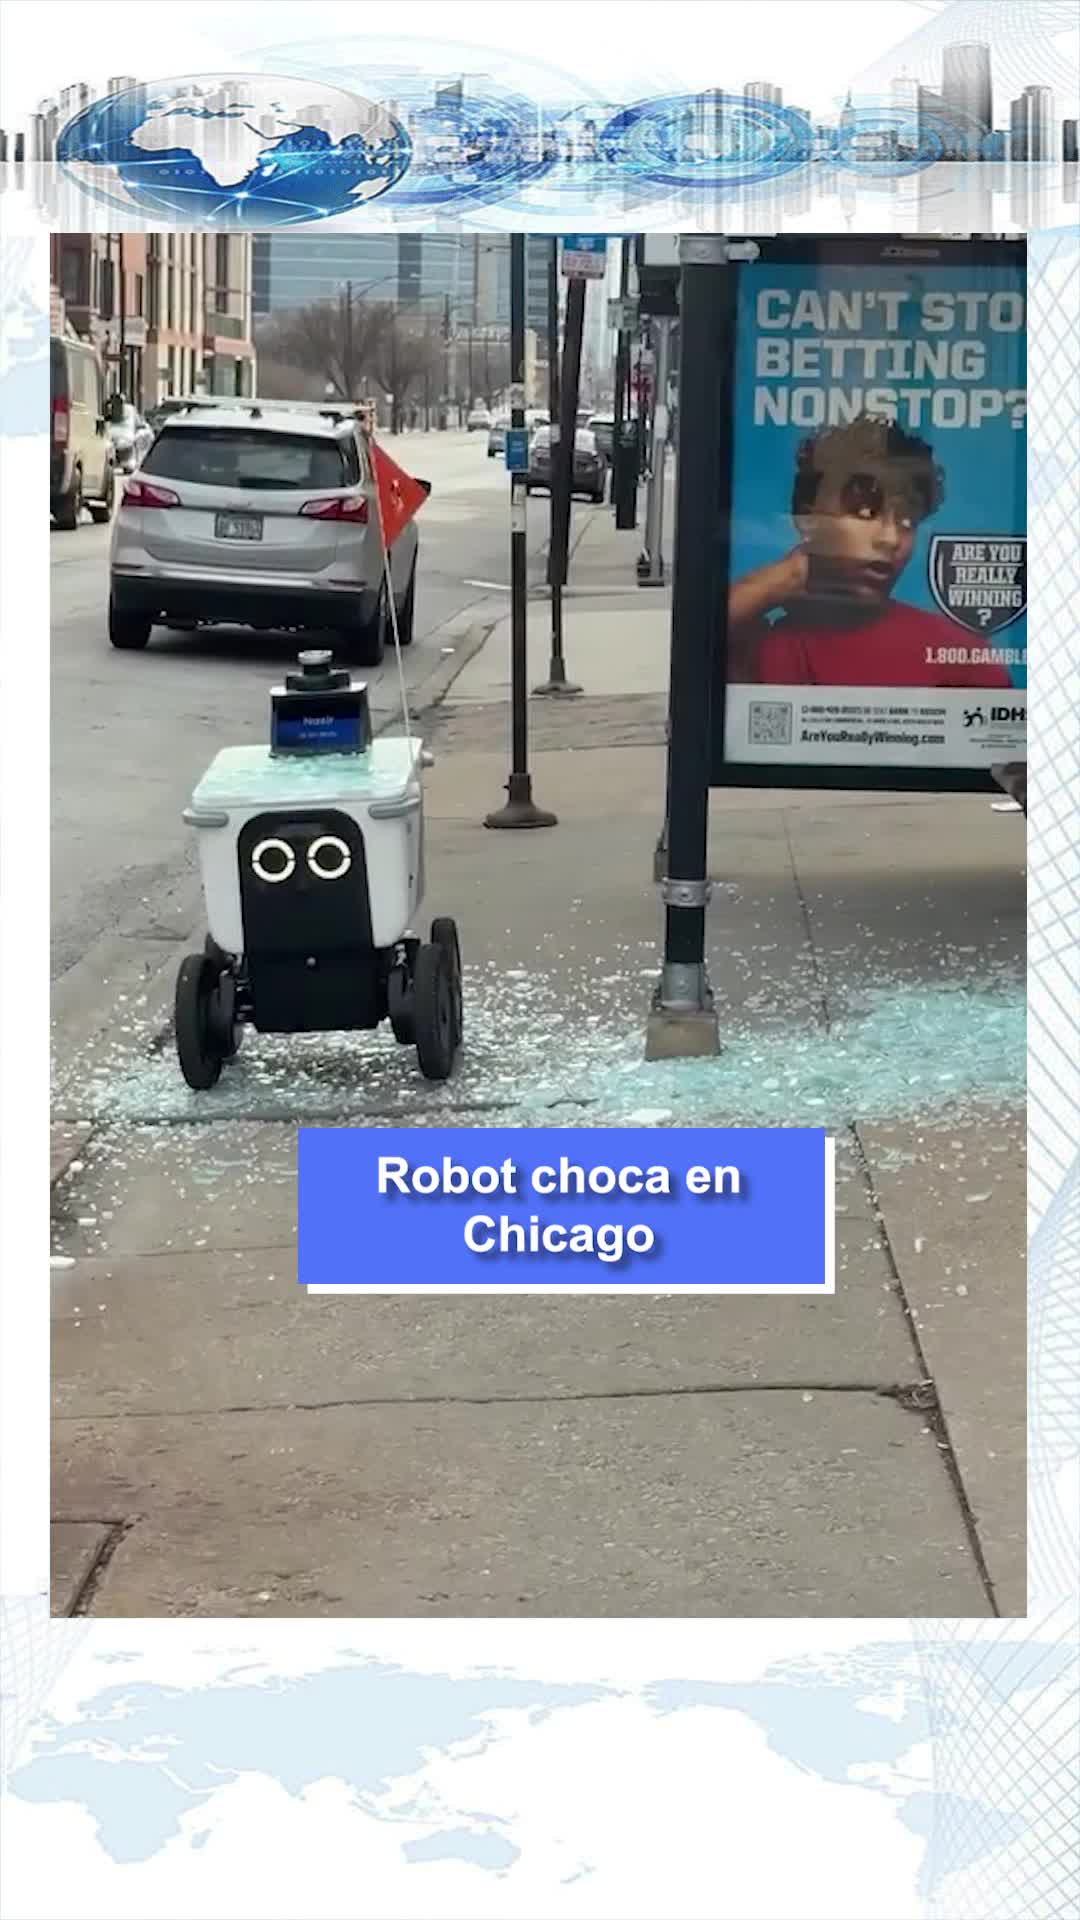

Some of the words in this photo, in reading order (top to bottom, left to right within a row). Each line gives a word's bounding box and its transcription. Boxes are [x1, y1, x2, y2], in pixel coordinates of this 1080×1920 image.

[756, 289, 908, 331] CAN'T
[756, 338, 986, 380] BETTING
[754, 386, 1027, 428] NONSTOP?
[952, 543, 986, 561] ARE
[988, 543, 1022, 562] YOU
[955, 566, 1018, 584] REALLY
[948, 589, 1022, 607] WINNING
[976, 607, 992, 626] ?
[990, 706, 1027, 721] IDH
